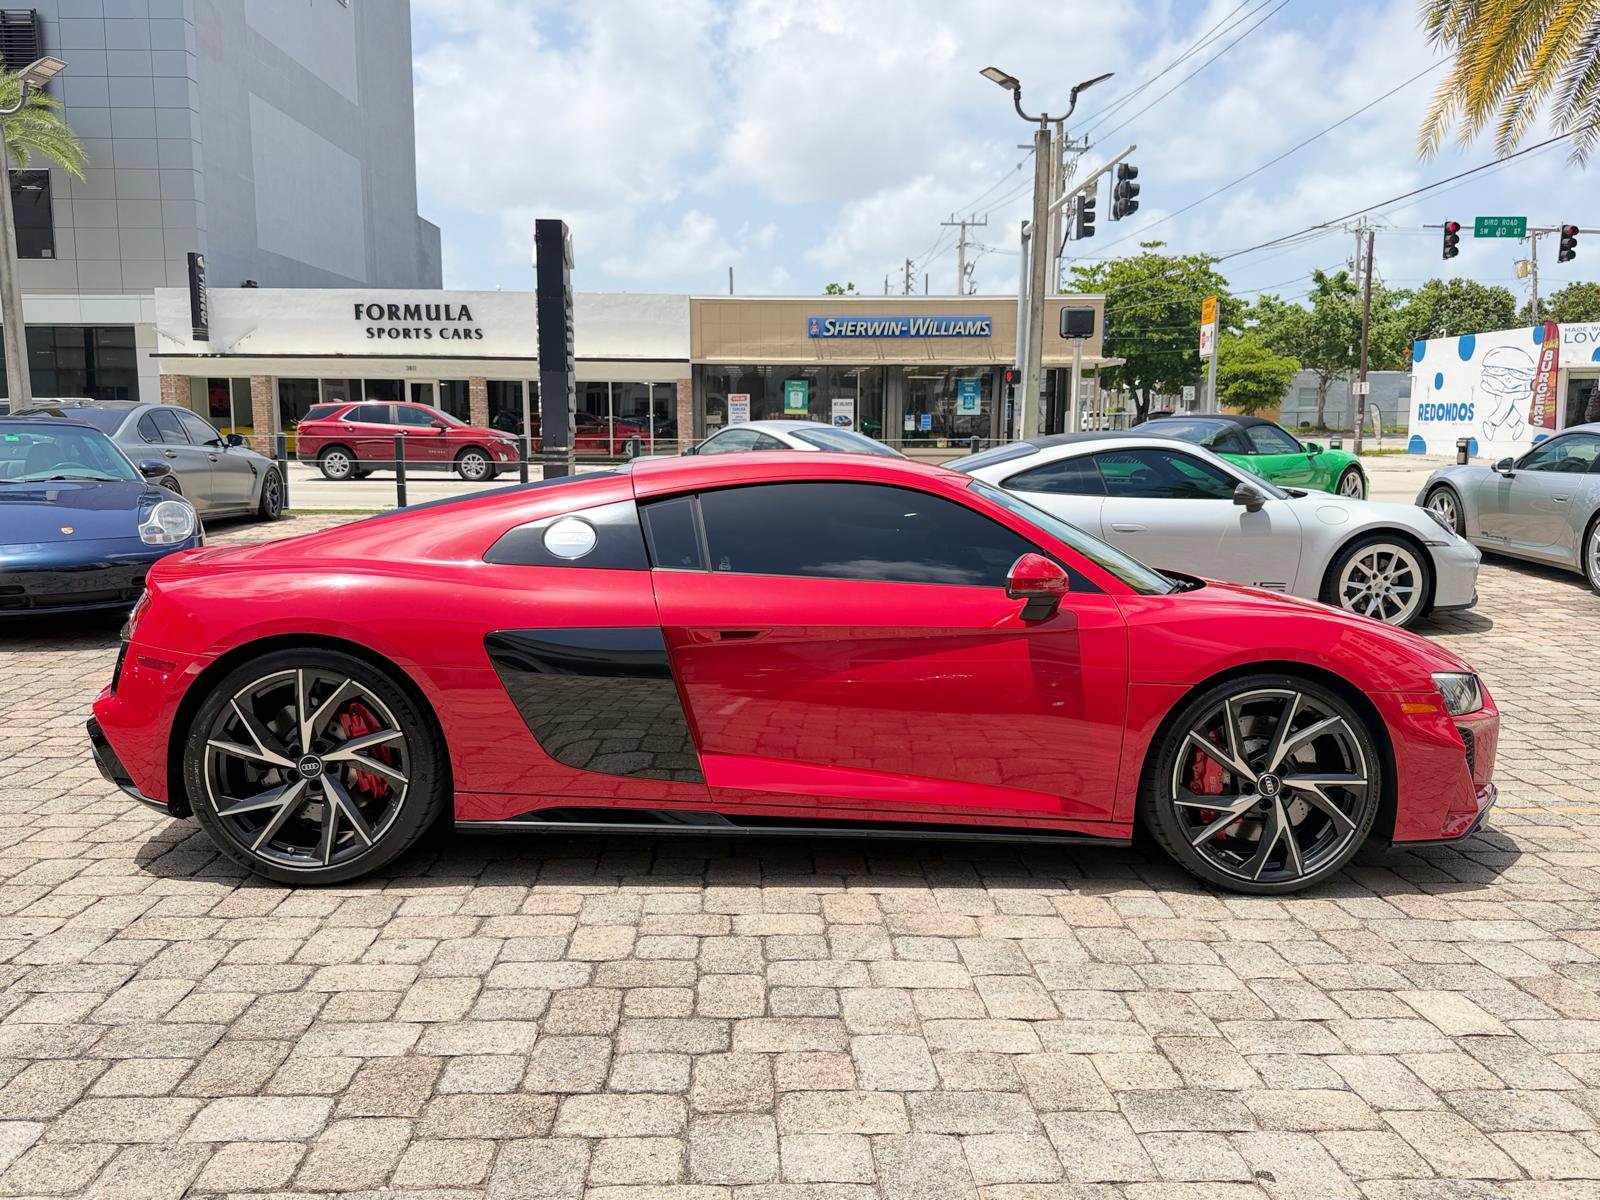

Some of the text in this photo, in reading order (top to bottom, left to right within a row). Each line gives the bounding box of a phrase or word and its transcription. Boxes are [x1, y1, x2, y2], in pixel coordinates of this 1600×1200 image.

[1496, 227, 1507, 237] 40
[197, 273, 208, 326] FORMULA
[354, 303, 474, 322] FORMULA
[366, 327, 484, 341] SPORTS CARS
[823, 317, 991, 337] SHERWIN-WILLIAMS
[1533, 349, 1554, 427] BURGERS
[1417, 402, 1475, 422] REDONDOS
